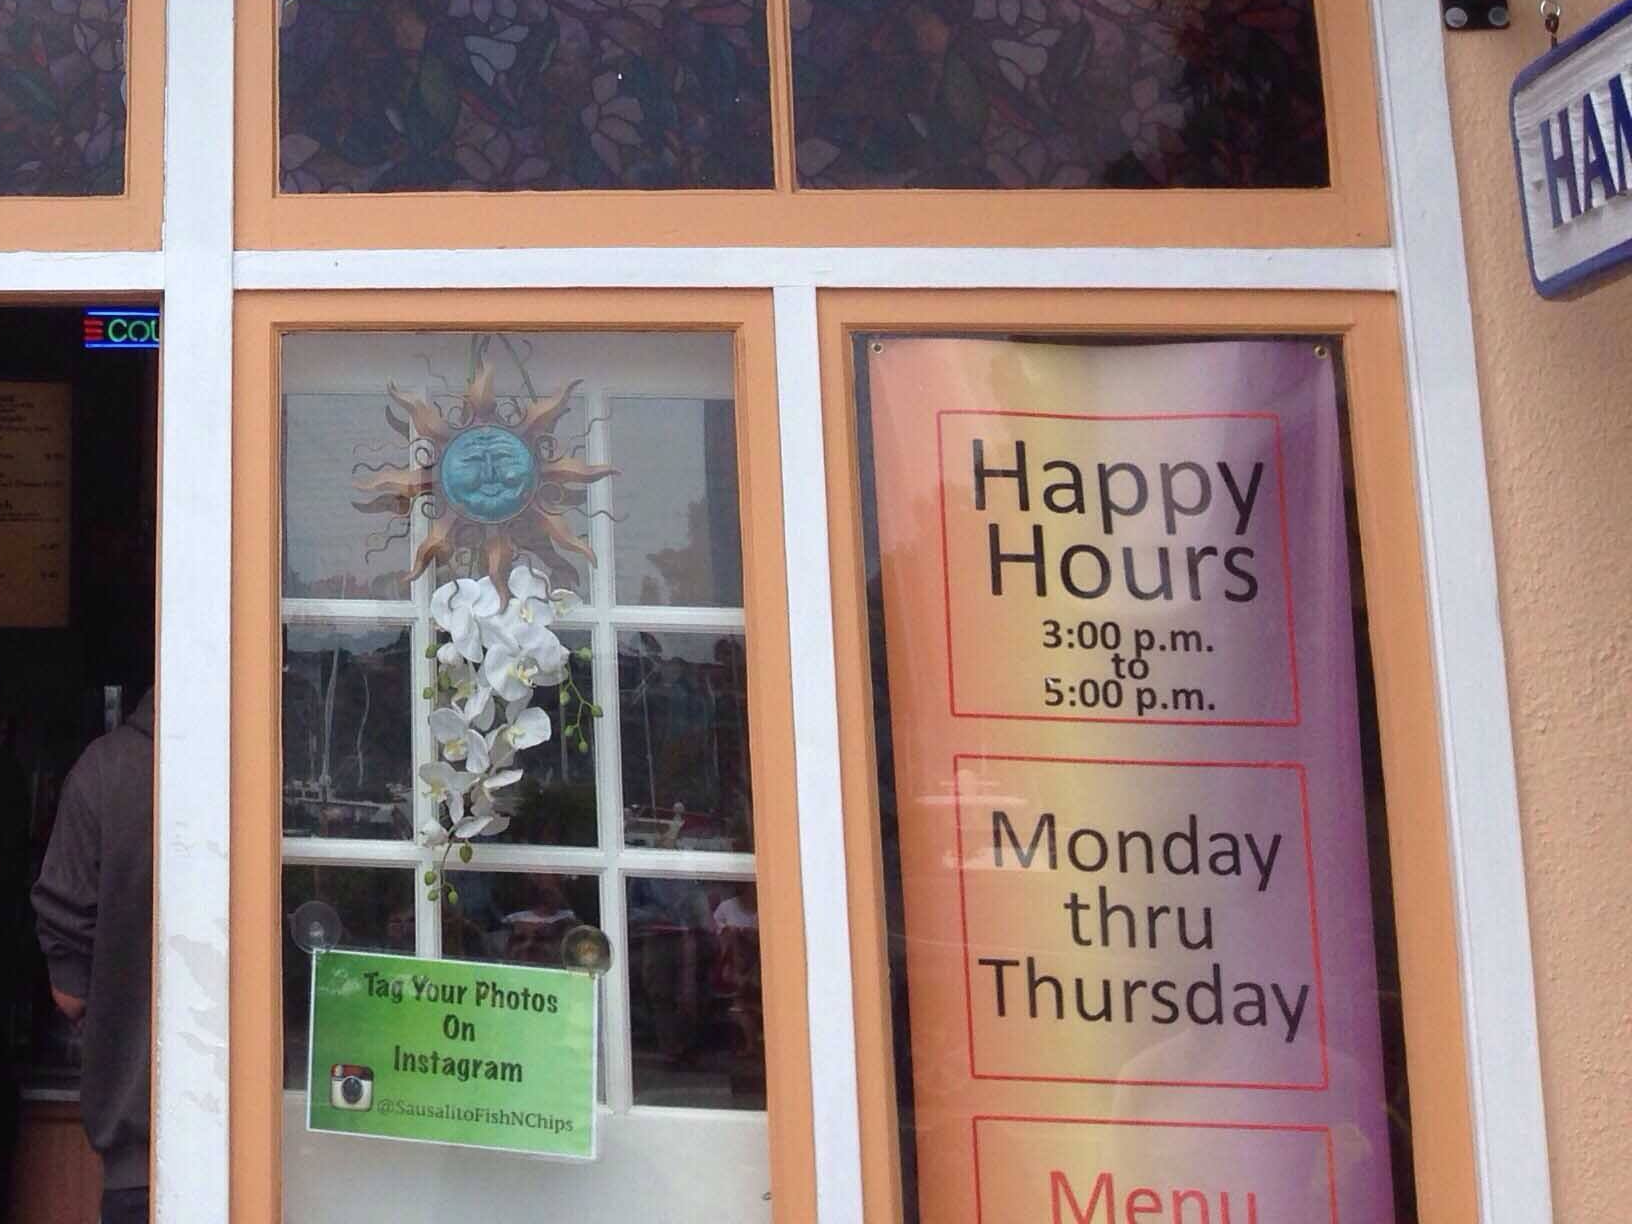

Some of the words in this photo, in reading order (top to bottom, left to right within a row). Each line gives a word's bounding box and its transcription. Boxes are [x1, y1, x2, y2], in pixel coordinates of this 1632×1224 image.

[971, 438, 1265, 536] Happy
[988, 522, 1259, 603] Hours
[1041, 619, 1122, 651] 3:00
[1134, 626, 1215, 658] p.m.
[1111, 652, 1150, 680] to
[1043, 678, 1124, 710] 5:00
[1136, 684, 1216, 716] p.m.
[990, 809, 1283, 892] Monday
[1063, 885, 1214, 951] thru
[364, 971, 404, 1004] Tag
[412, 975, 468, 1005] Your
[475, 979, 559, 1014] Photos
[977, 956, 1310, 1044] Thursday
[442, 1013, 476, 1042] On
[393, 1045, 523, 1082] Instagram
[376, 1098, 574, 1135] @SausalitoFishNChips
[1048, 1169, 1258, 1224] Menu
